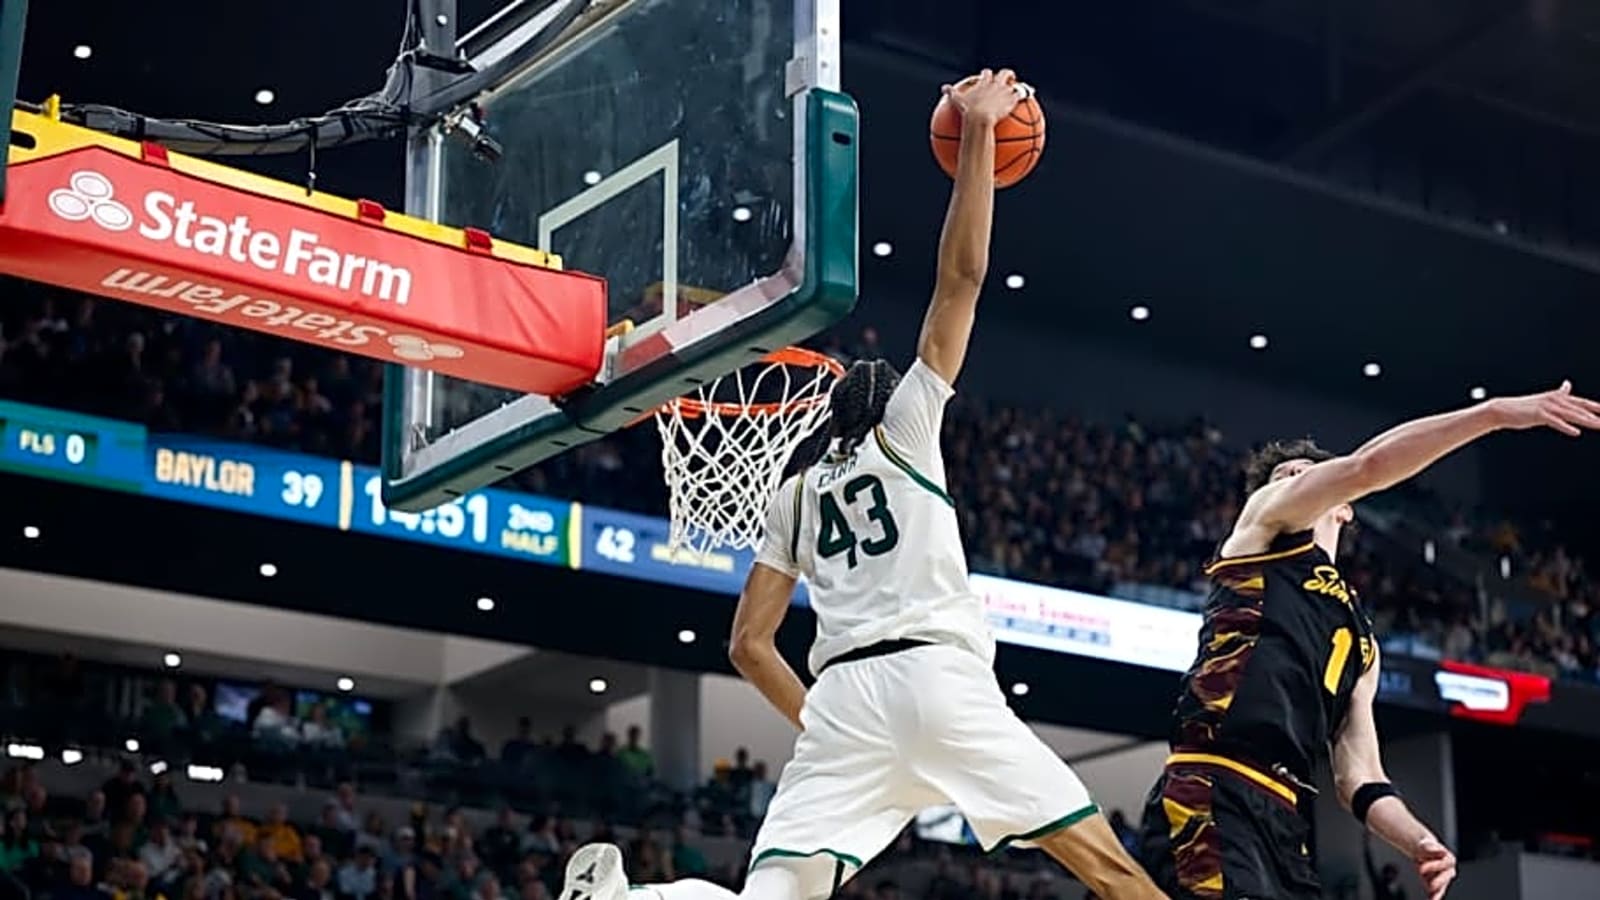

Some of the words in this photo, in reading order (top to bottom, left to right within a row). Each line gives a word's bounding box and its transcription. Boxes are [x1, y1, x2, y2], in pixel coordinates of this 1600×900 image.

[155, 447, 255, 497] BAYLOR
[281, 470, 324, 509] 39
[595, 525, 635, 563] 42
[816, 473, 900, 570] 43
[1323, 626, 1354, 697] 1
